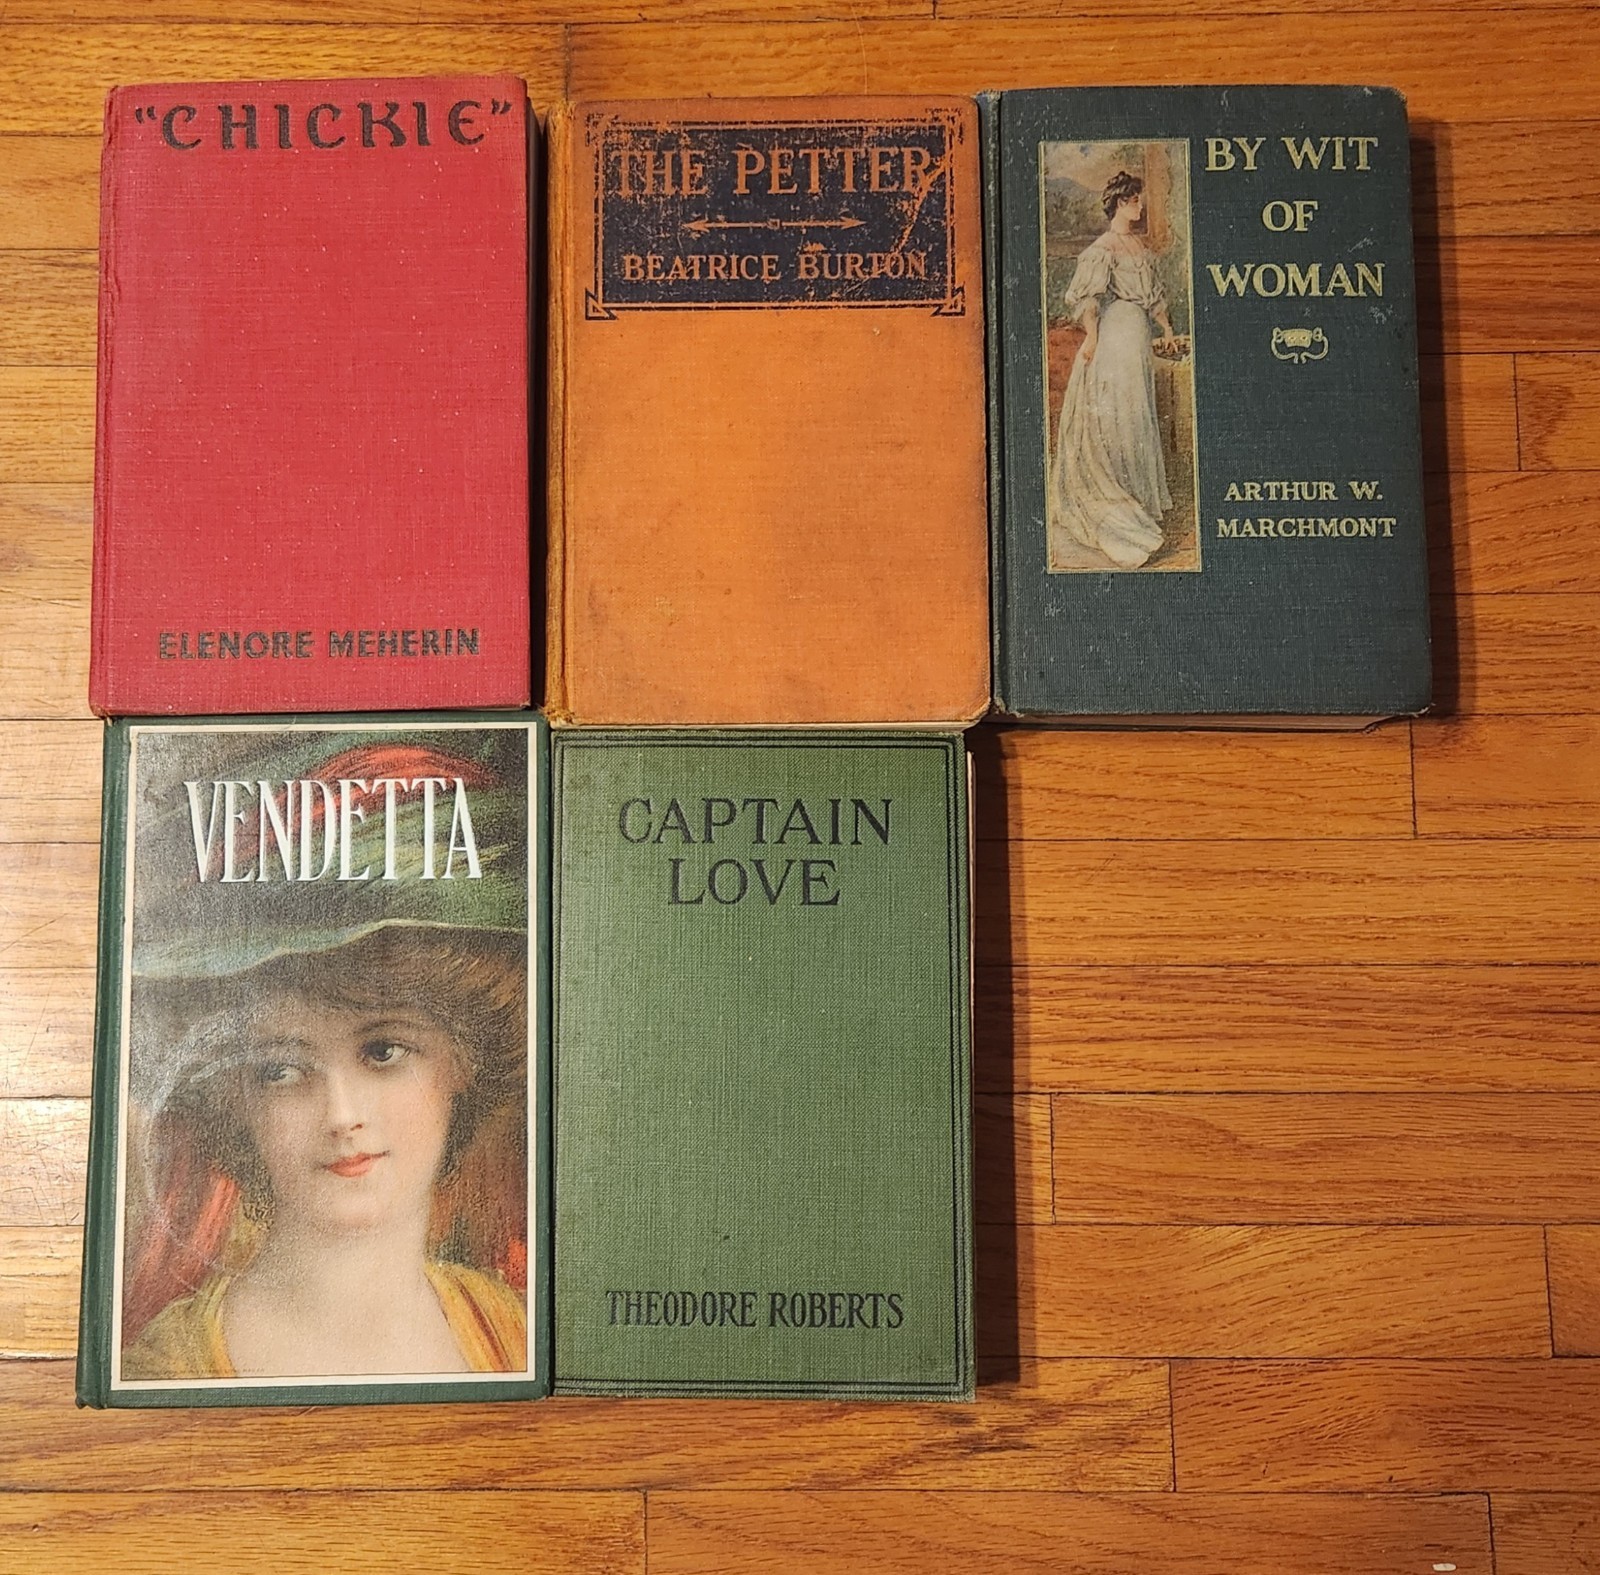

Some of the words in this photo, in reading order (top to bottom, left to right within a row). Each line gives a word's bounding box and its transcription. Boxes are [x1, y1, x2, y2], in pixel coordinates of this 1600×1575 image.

[1204, 137, 1266, 171] BY
[1280, 136, 1378, 170] WIT
[609, 149, 706, 197] THE
[732, 146, 934, 195] PETTER
[1262, 200, 1318, 231] OF
[623, 253, 781, 281] BEATRICE
[799, 251, 926, 280] BURTON
[1206, 262, 1385, 297] WOMAN
[1224, 480, 1338, 501] ARTHUR
[1348, 480, 1383, 500] W.
[1216, 517, 1397, 538] MARCHMONT
[159, 630, 313, 660] ELENORE
[328, 628, 480, 657] MEHERIN
[183, 777, 482, 883] VENDETTA
[618, 798, 893, 845] CAPTAIN
[667, 858, 841, 906] LOVE
[605, 1290, 758, 1327] THEODORE
[768, 1292, 905, 1329] ROBERTS
